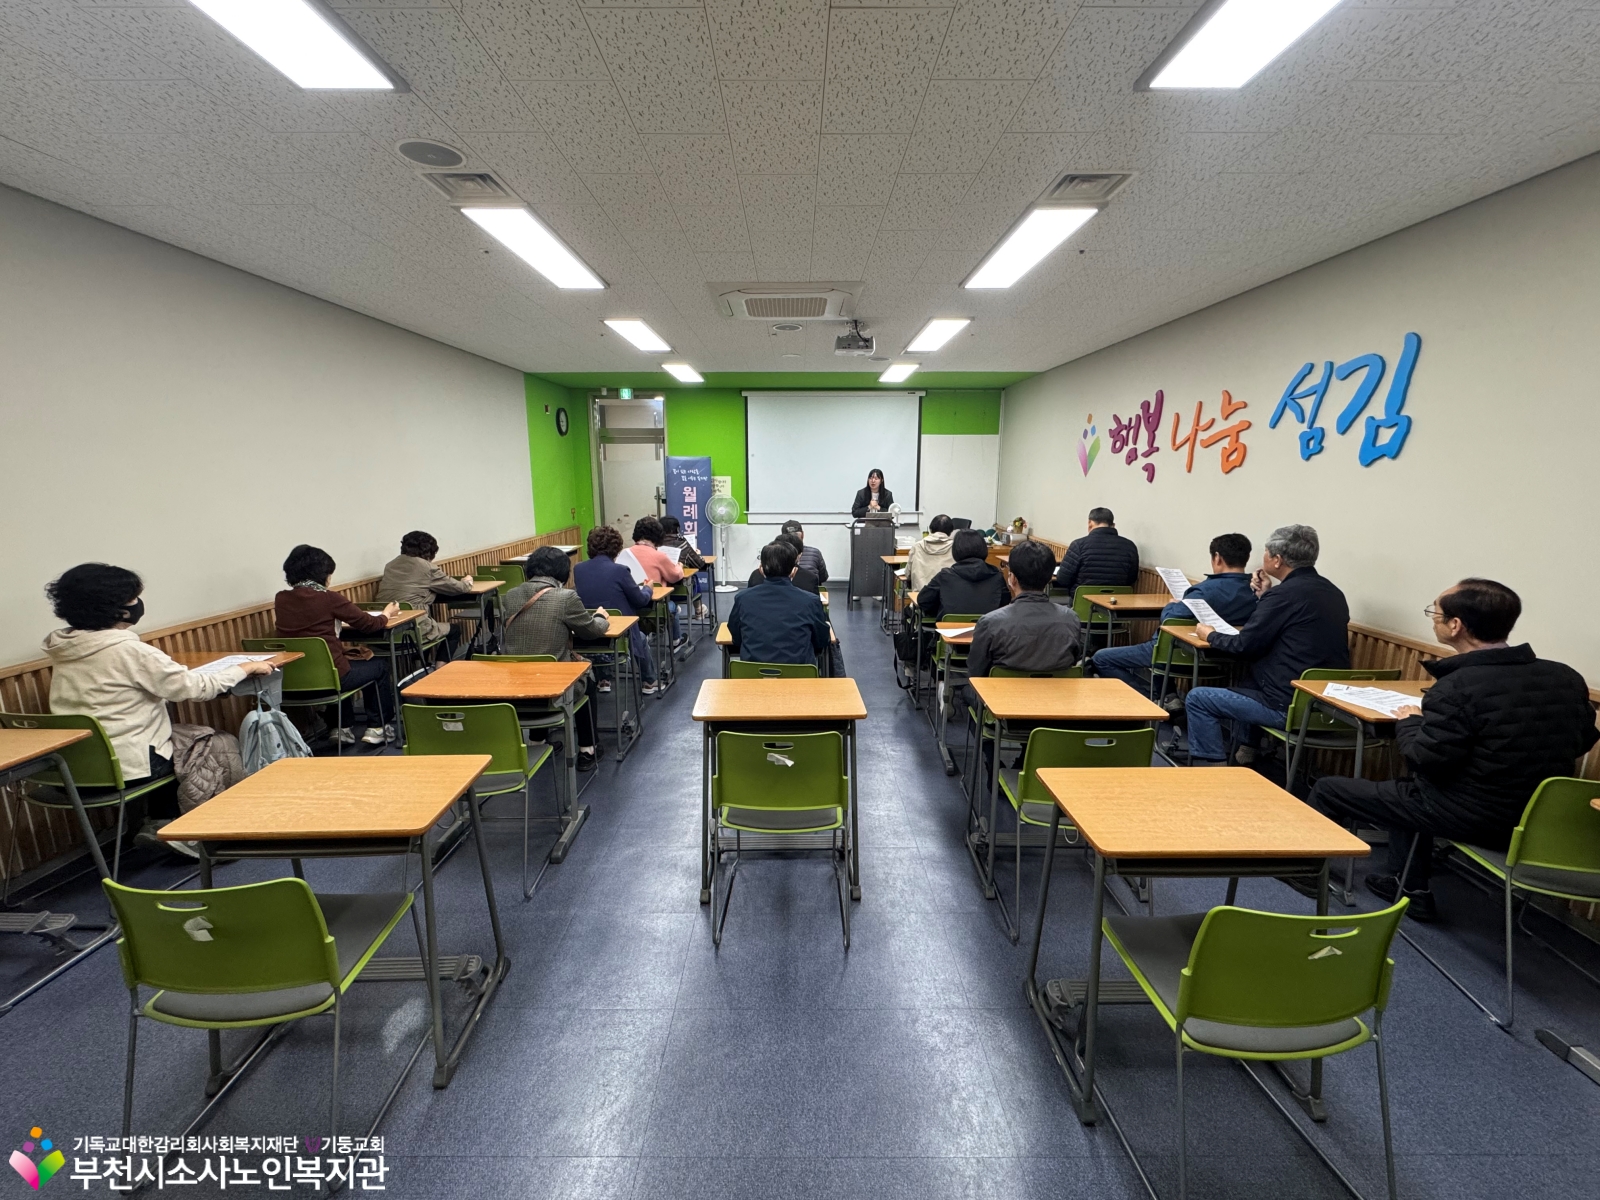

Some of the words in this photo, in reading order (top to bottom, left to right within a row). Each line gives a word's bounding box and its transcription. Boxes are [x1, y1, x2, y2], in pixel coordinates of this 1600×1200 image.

[1108, 389, 1164, 483] 행복
[1171, 389, 1252, 474] 나눔
[1269, 332, 1422, 467] 섬김
[682, 486, 698, 549] 월례회
